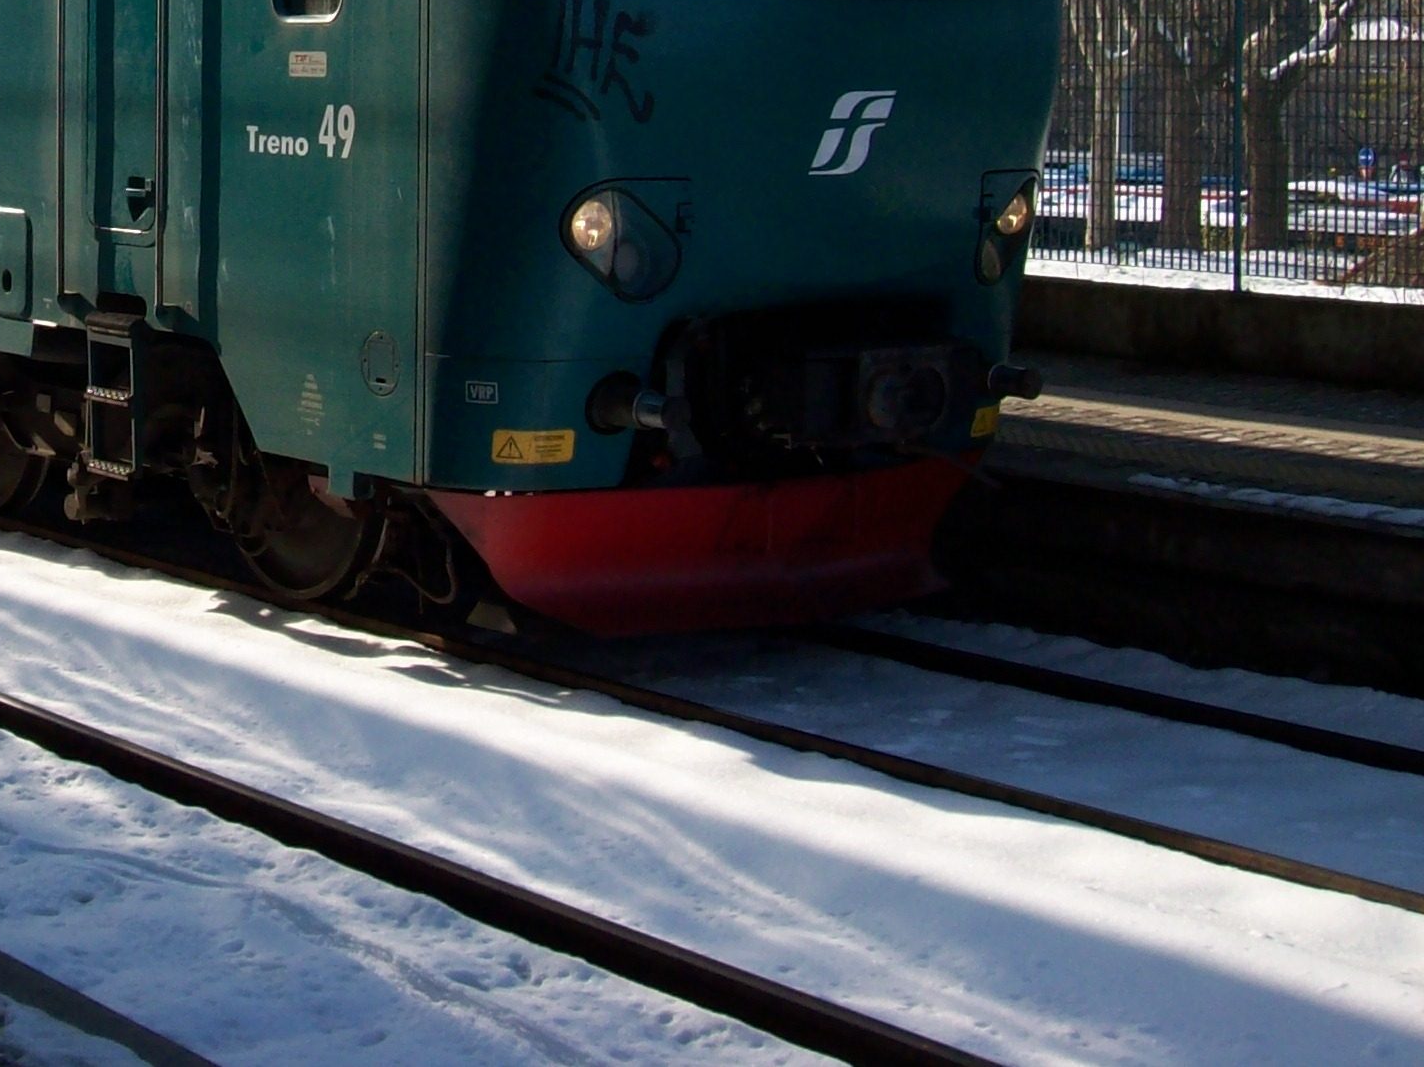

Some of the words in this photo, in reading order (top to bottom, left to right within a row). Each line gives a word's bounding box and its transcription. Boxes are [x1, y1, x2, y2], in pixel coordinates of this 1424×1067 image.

[246, 125, 309, 156] Treno
[318, 104, 355, 159] 49
[470, 384, 495, 400] VRP
